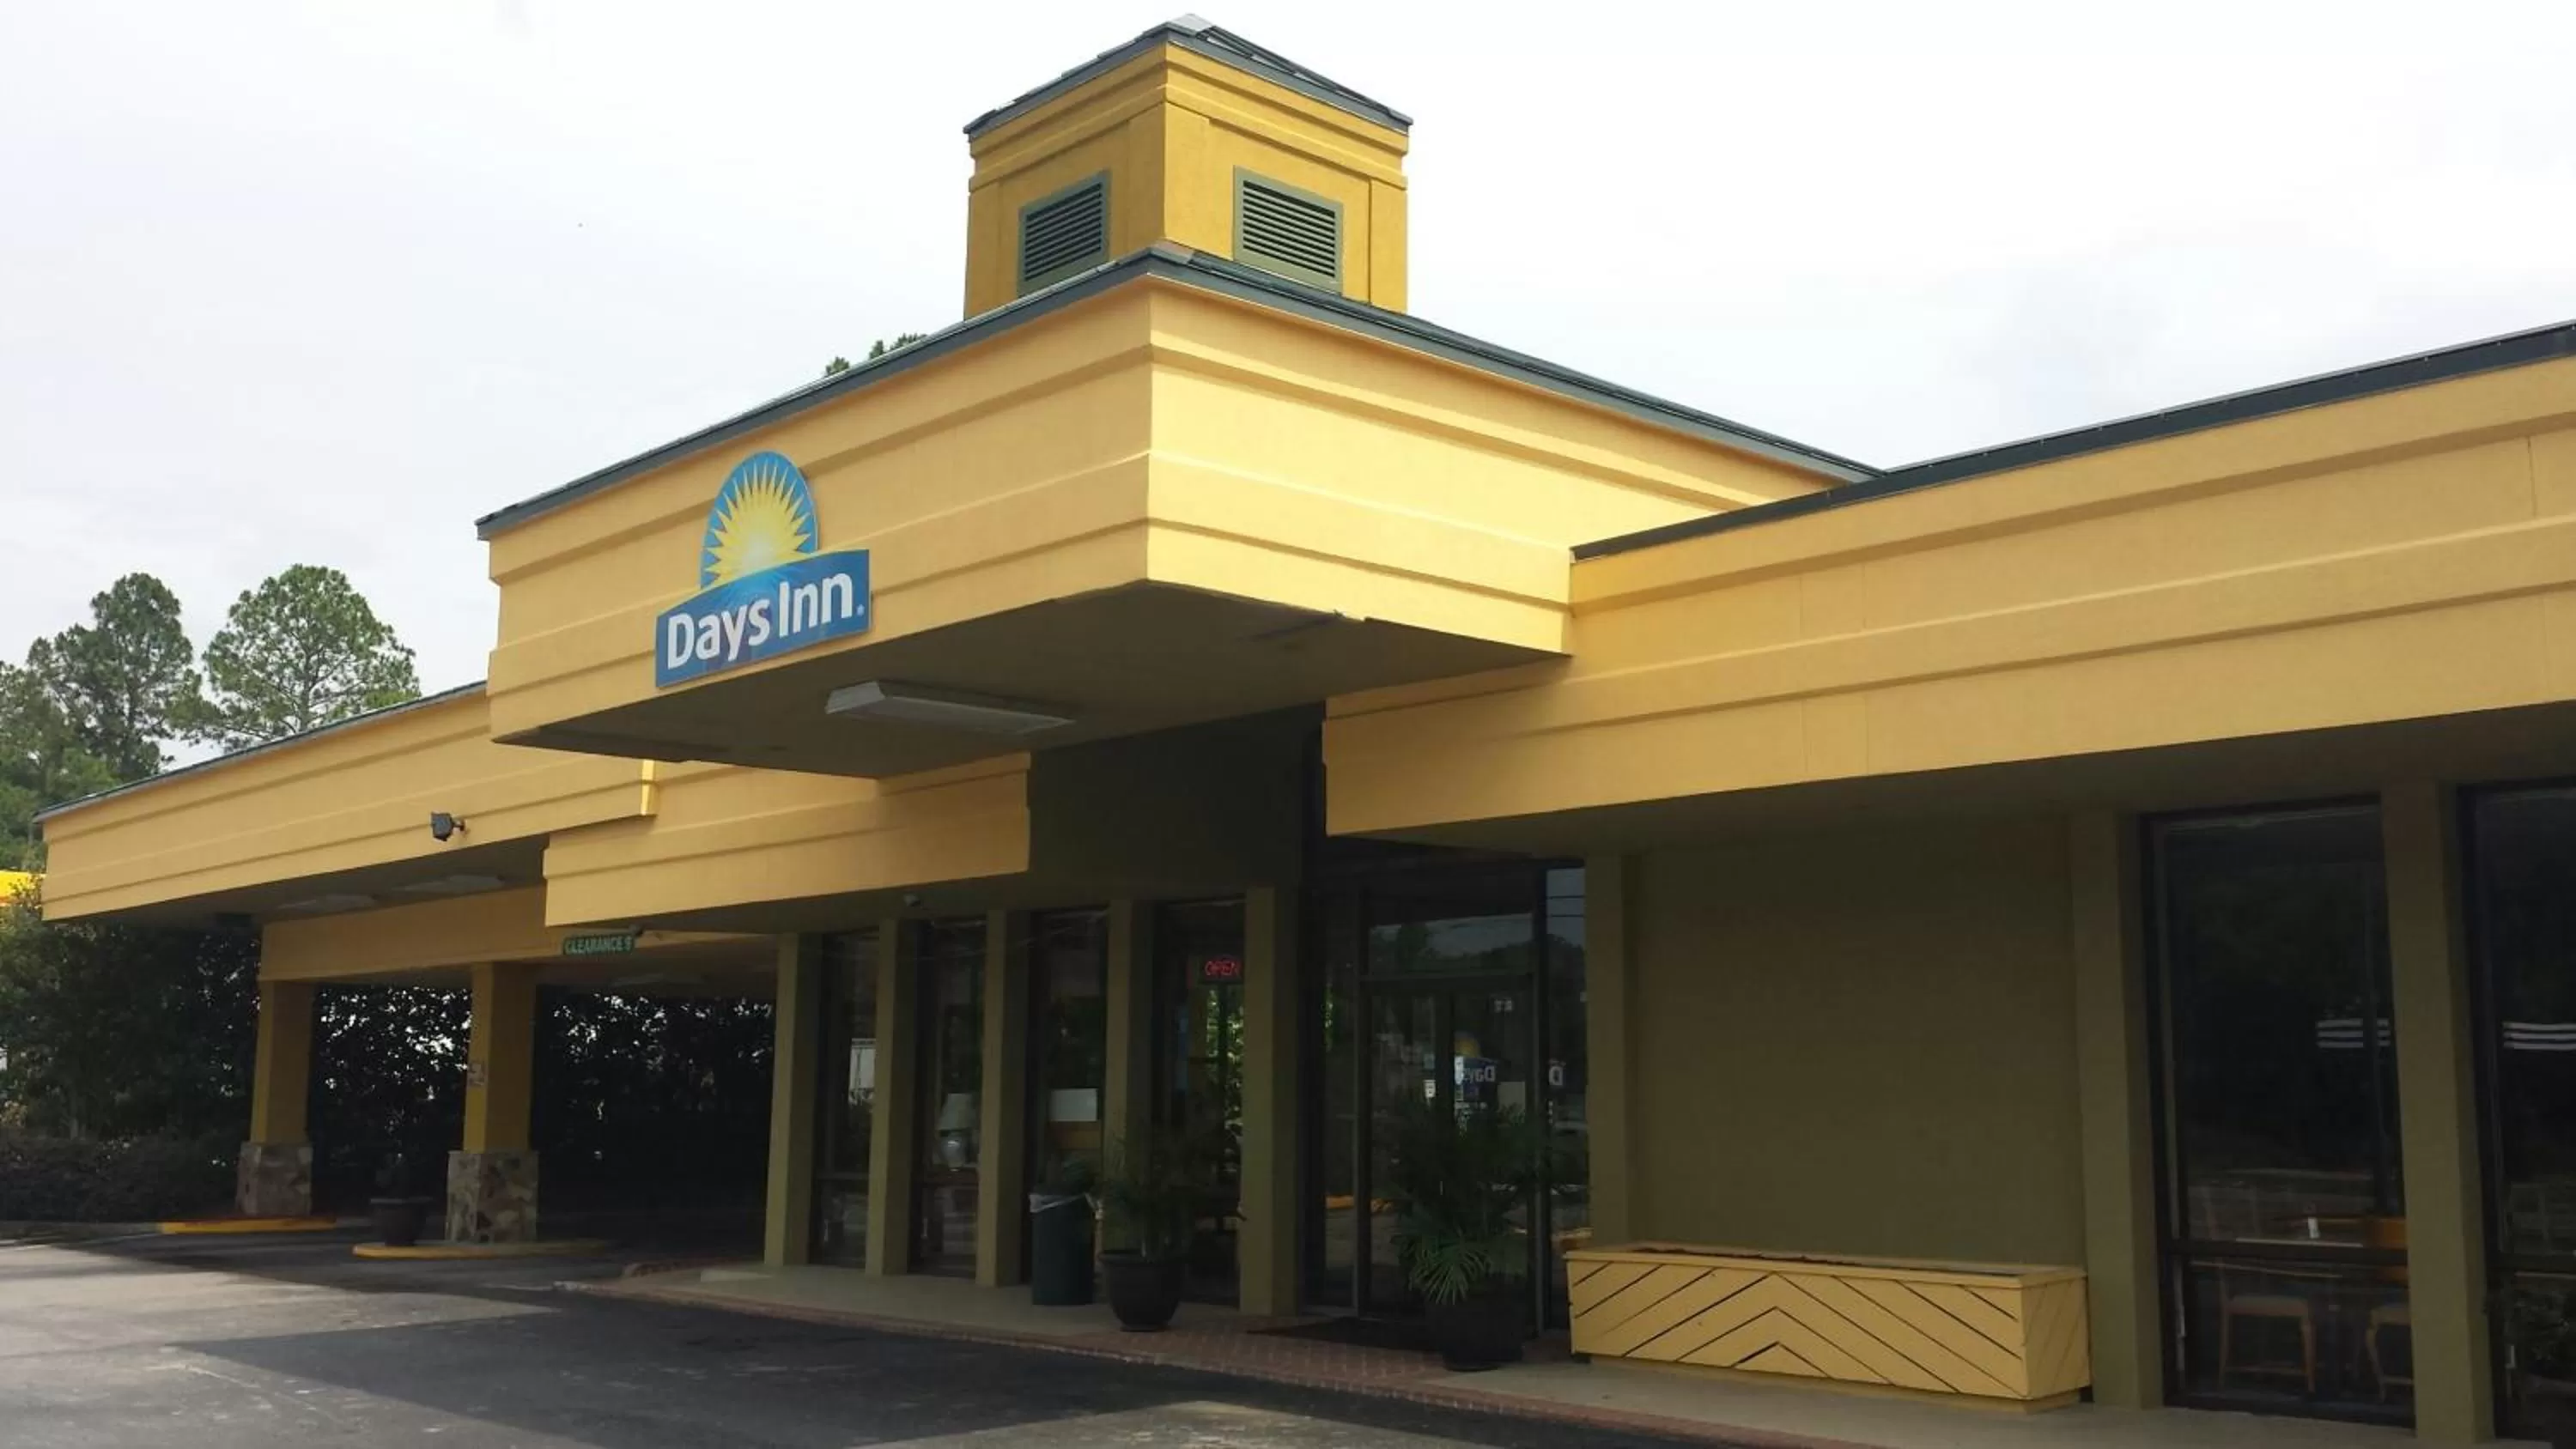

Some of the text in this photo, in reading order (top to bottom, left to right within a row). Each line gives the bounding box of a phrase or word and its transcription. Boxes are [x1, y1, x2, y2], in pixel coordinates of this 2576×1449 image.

[667, 573, 853, 670] Days Inn
[1205, 960, 1241, 976] OPEN
